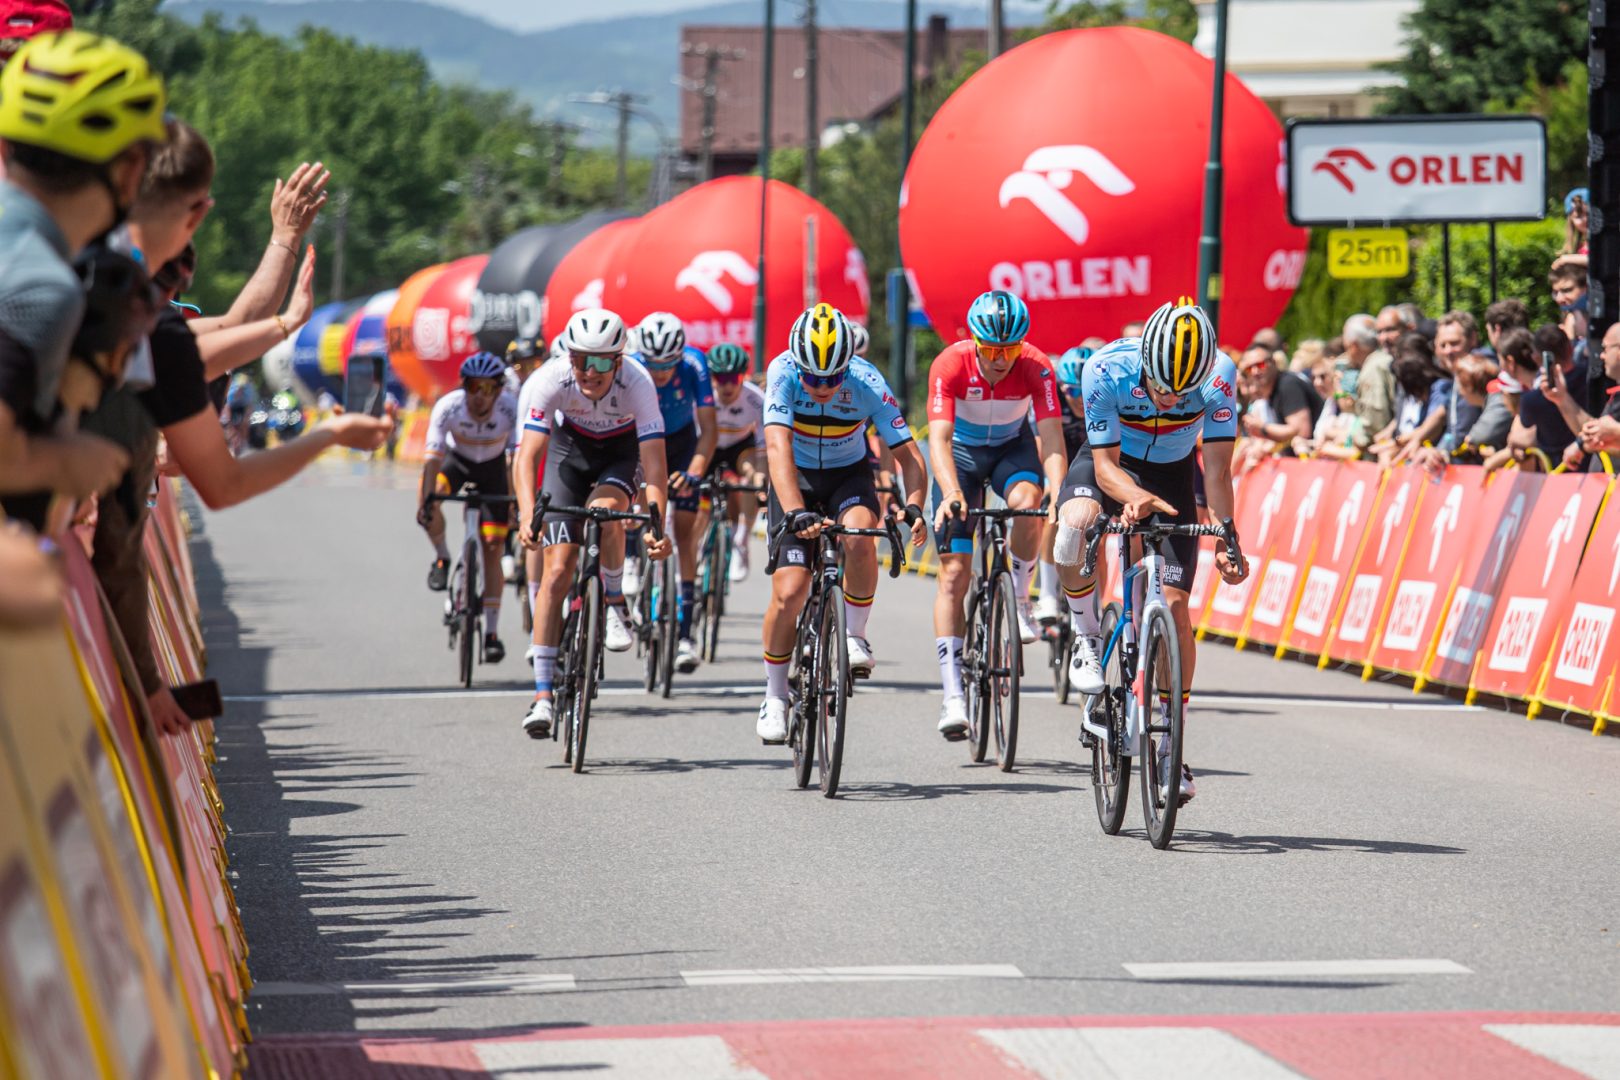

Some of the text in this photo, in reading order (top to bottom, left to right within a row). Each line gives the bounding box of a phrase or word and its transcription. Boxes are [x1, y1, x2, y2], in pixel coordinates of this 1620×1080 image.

[1389, 154, 1523, 185] ORLEN
[1337, 238, 1402, 267] 25m
[989, 255, 1151, 301] ORLEN
[1163, 565, 1183, 574] ELGIAN
